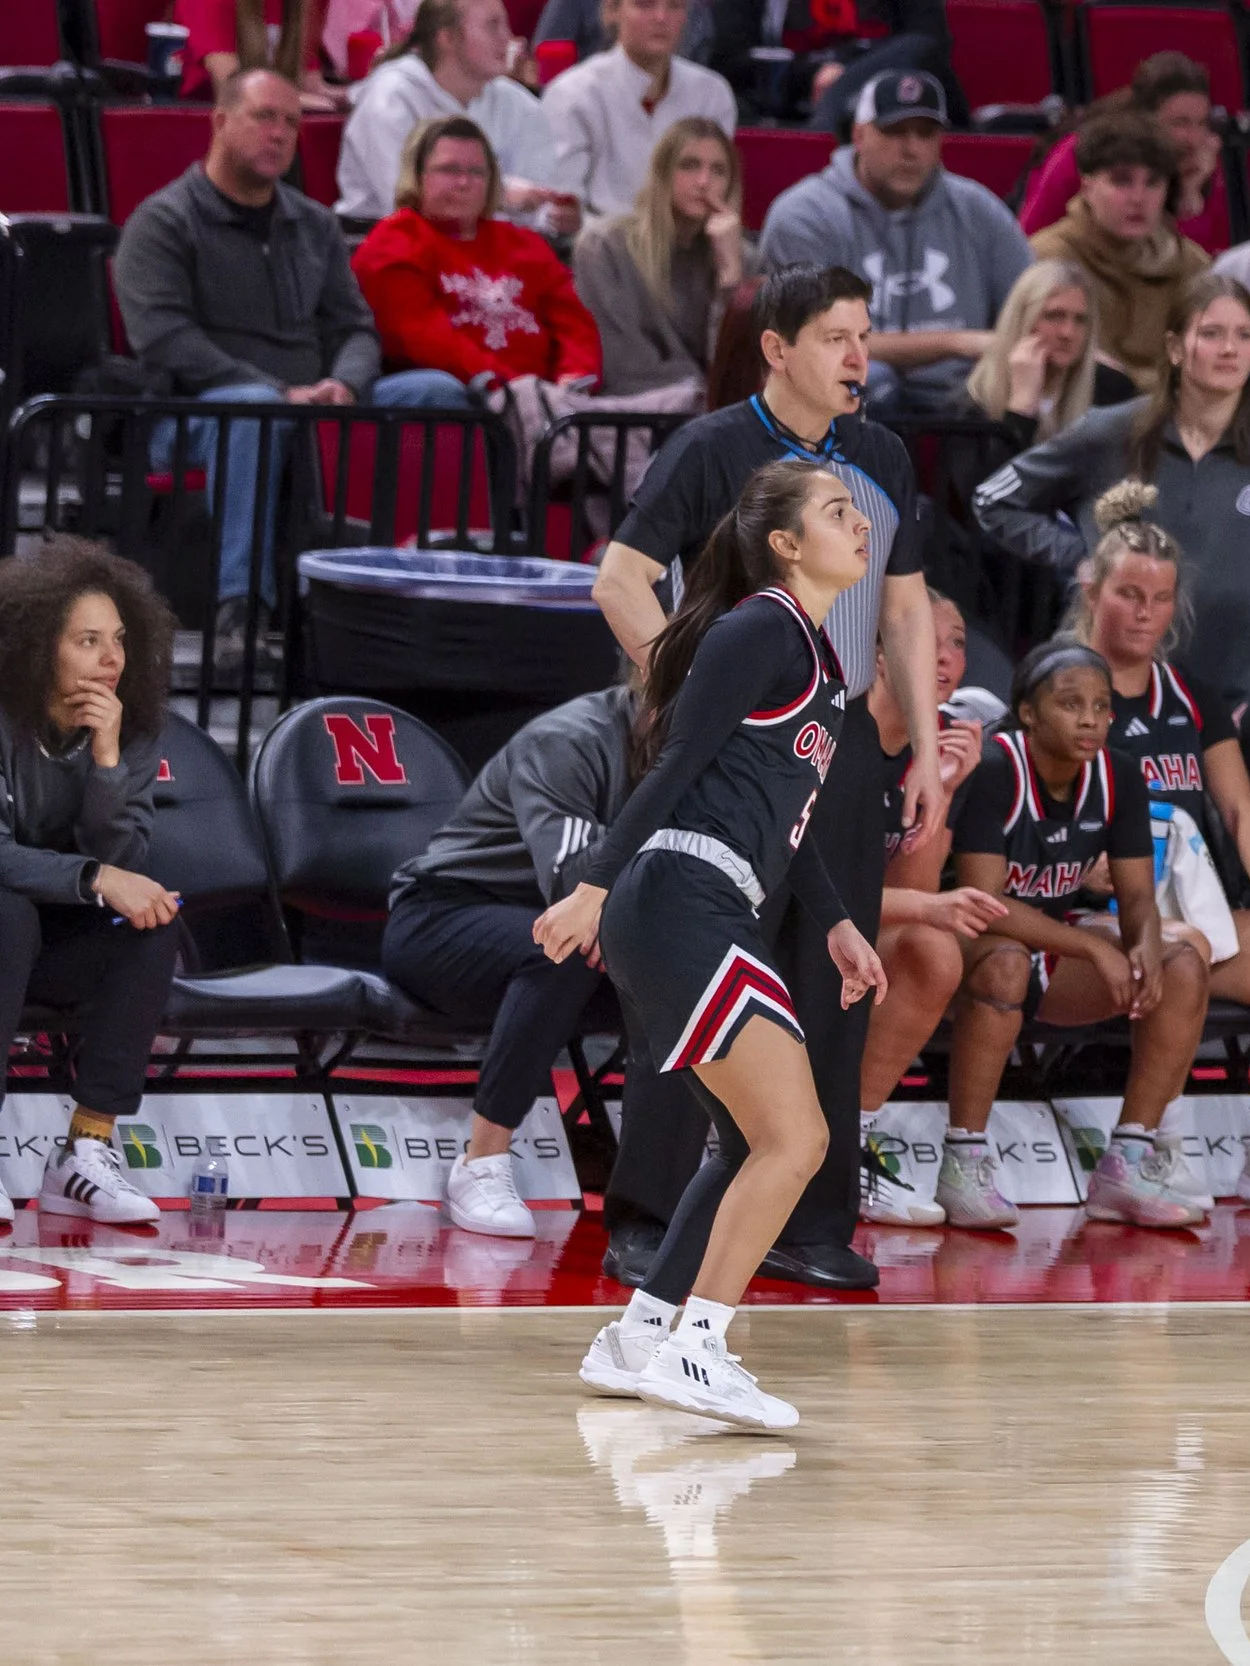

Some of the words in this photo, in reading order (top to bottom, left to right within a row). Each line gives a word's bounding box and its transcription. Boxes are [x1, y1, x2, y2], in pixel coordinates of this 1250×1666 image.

[323, 714, 408, 785] N
[1140, 752, 1203, 791] AHA
[1005, 857, 1095, 898] MAH
[174, 1135, 329, 1157] BECK'S
[912, 1142, 1057, 1163] BK'S
